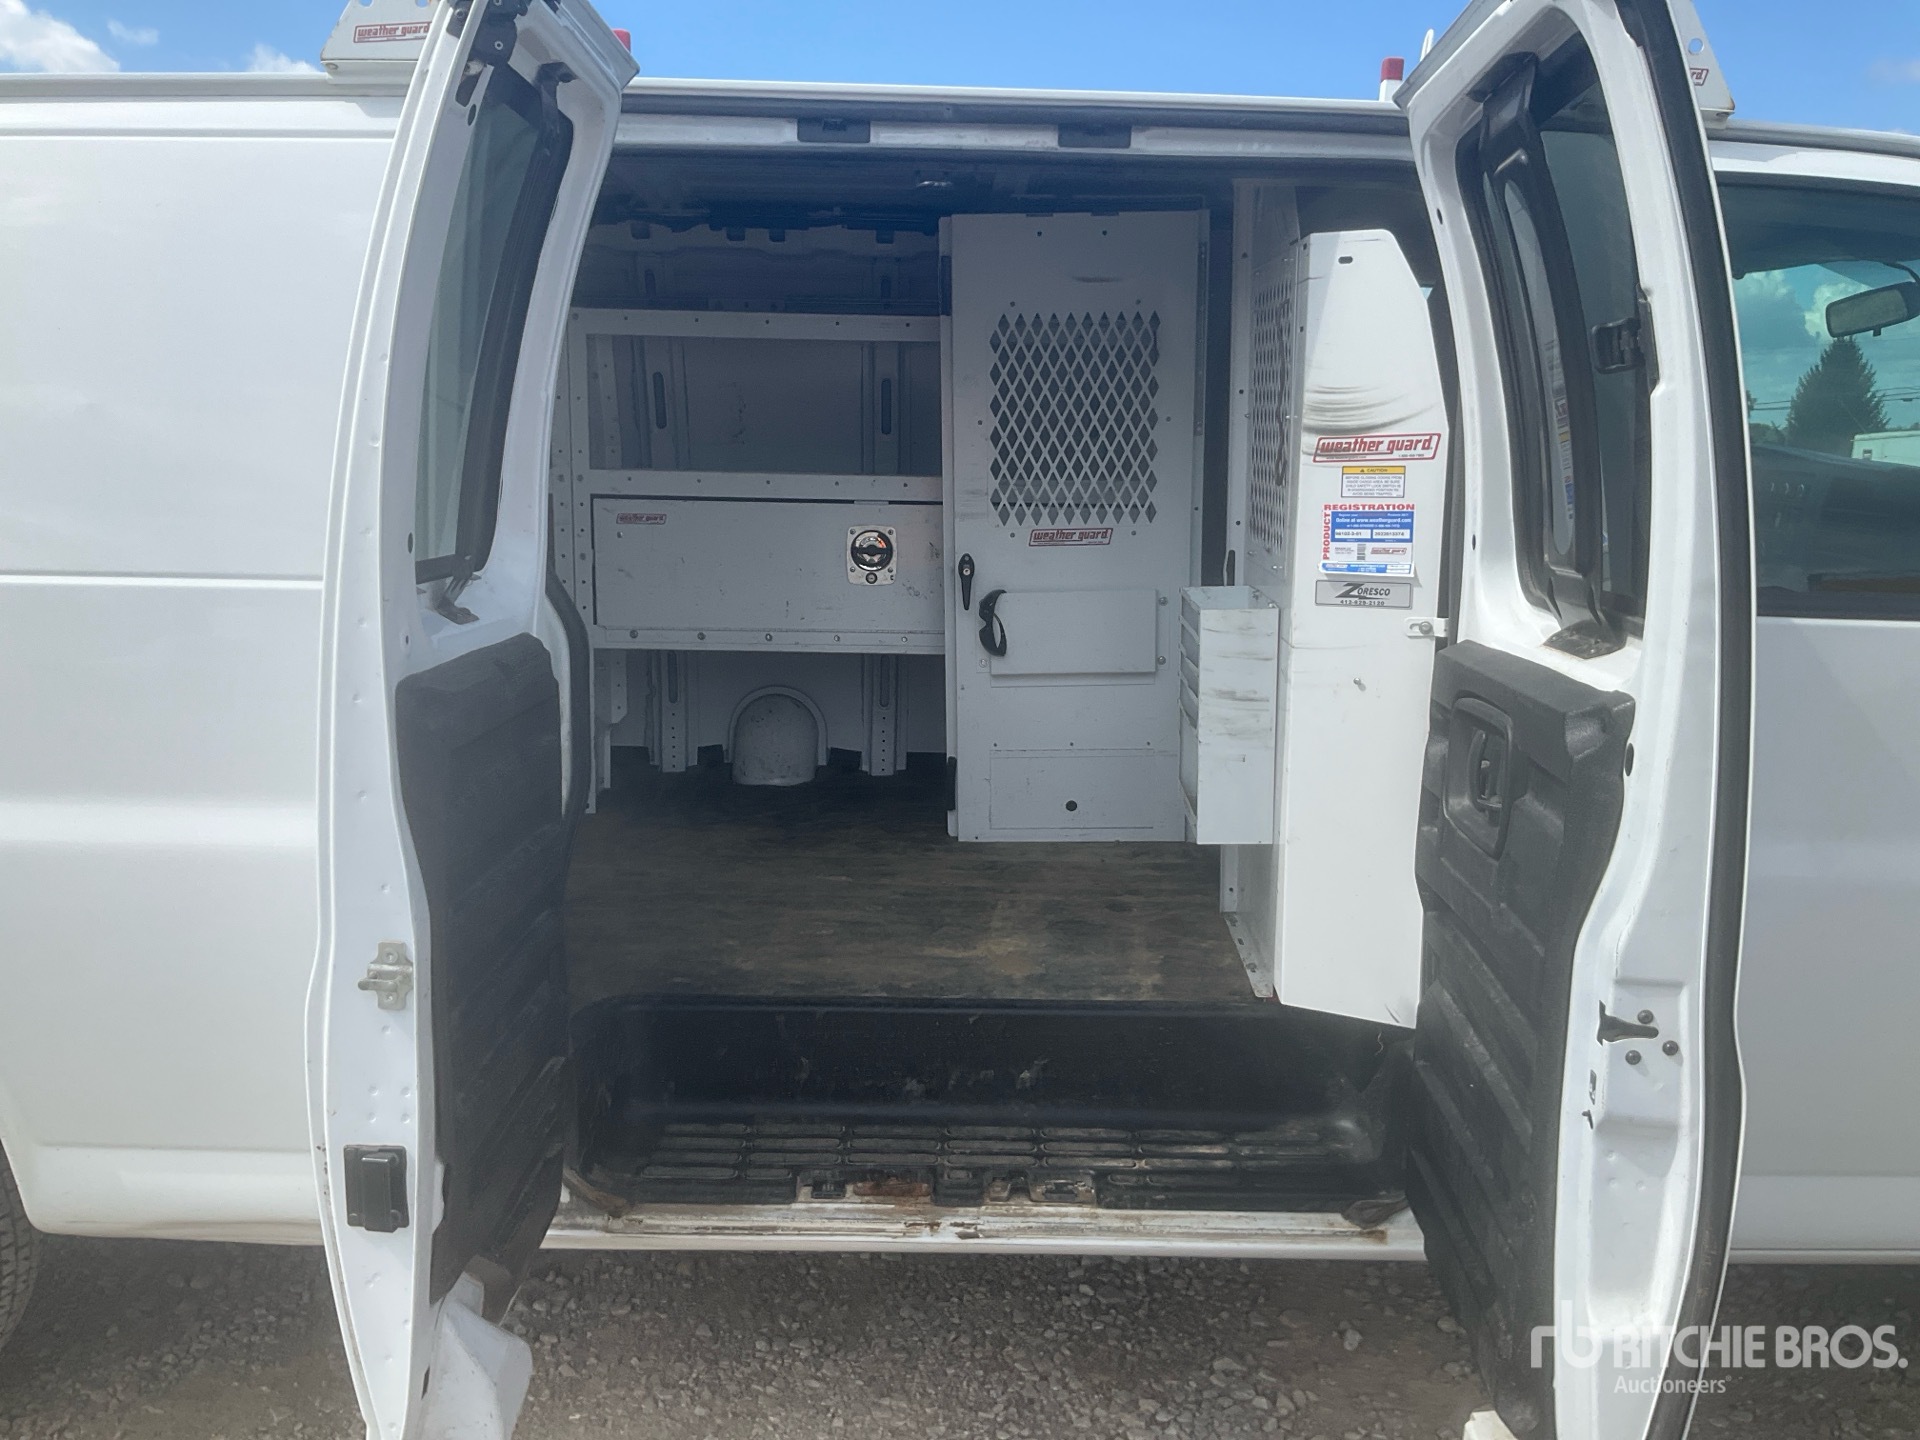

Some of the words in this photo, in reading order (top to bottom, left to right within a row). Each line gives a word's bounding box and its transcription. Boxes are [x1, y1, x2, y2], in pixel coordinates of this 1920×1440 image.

[357, 25, 399, 36] weather
[401, 22, 430, 36] guard
[1320, 438, 1384, 453] weather
[1387, 435, 1432, 454] guard
[1033, 529, 1076, 540] weather
[1078, 529, 1108, 541] guard
[1323, 512, 1331, 560] PRODUCT
[1334, 582, 1391, 599] ZORESCO
